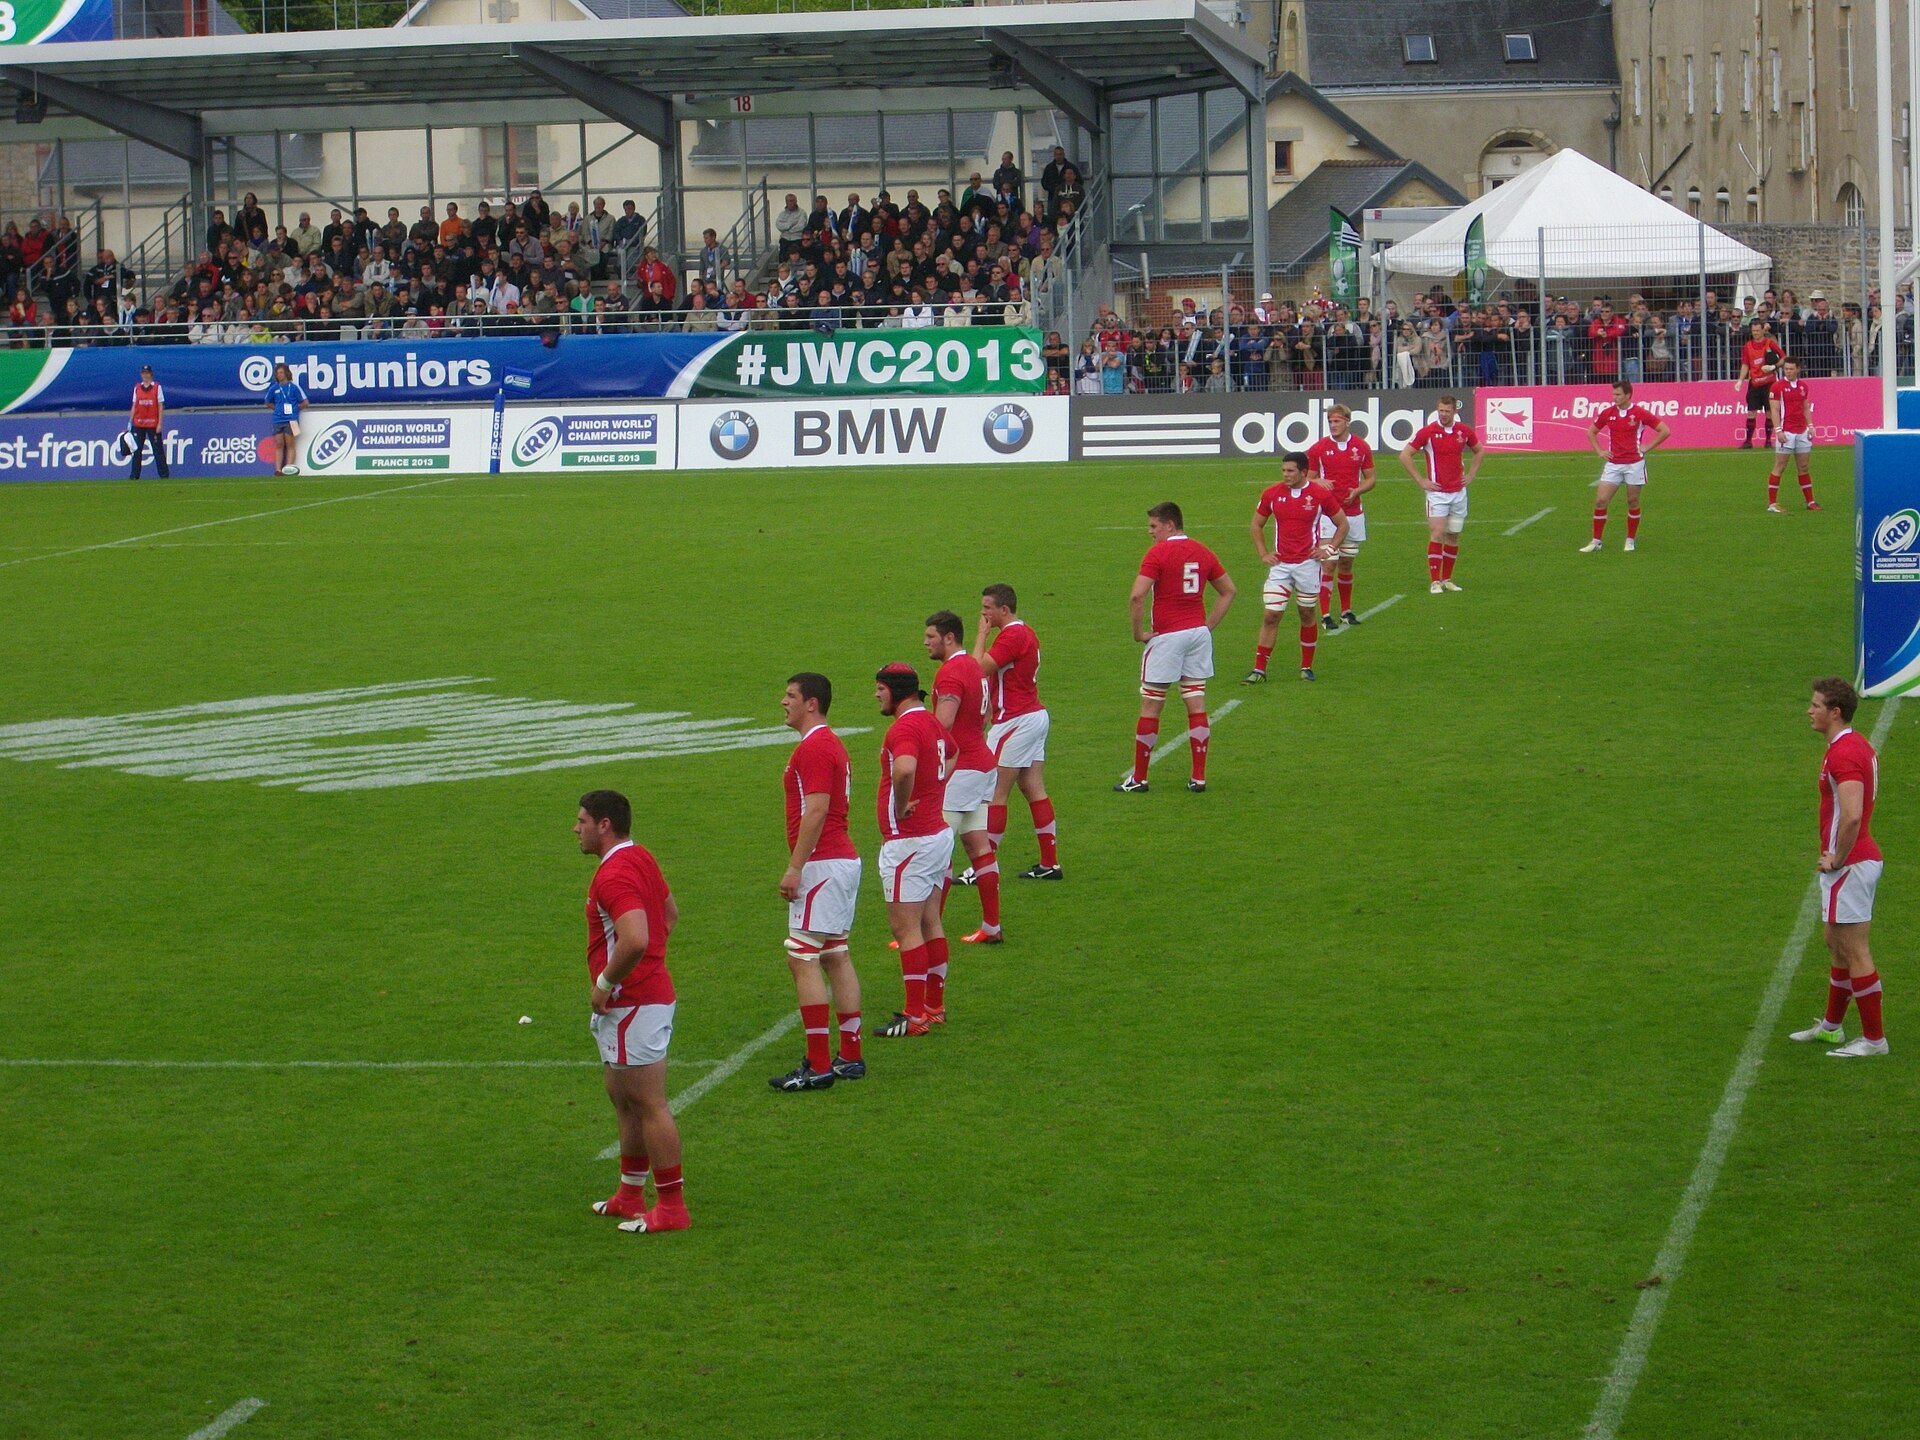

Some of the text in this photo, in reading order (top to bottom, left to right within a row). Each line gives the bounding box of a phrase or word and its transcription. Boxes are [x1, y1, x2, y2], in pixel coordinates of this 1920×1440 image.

[734, 95, 751, 112] 18
[736, 339, 1044, 386] #JWC2013
[1552, 407, 1568, 419] La
[1684, 406, 1701, 415] au
[1704, 402, 1732, 418] plus
[362, 422, 446, 433] JUNIOR WORLD
[568, 419, 652, 430] JUNIOR WORLD
[794, 407, 947, 456] BMW
[208, 434, 256, 451] ouest
[362, 434, 446, 445] CHAMPIONSHIP
[568, 430, 652, 441] CHAMPIONSHIP
[201, 447, 256, 465] france
[372, 458, 433, 467] FRANCE 2013
[577, 454, 640, 463] FRANCE 2013
[1182, 562, 1200, 594] 5
[980, 677, 990, 716] 8
[936, 738, 947, 781] 3
